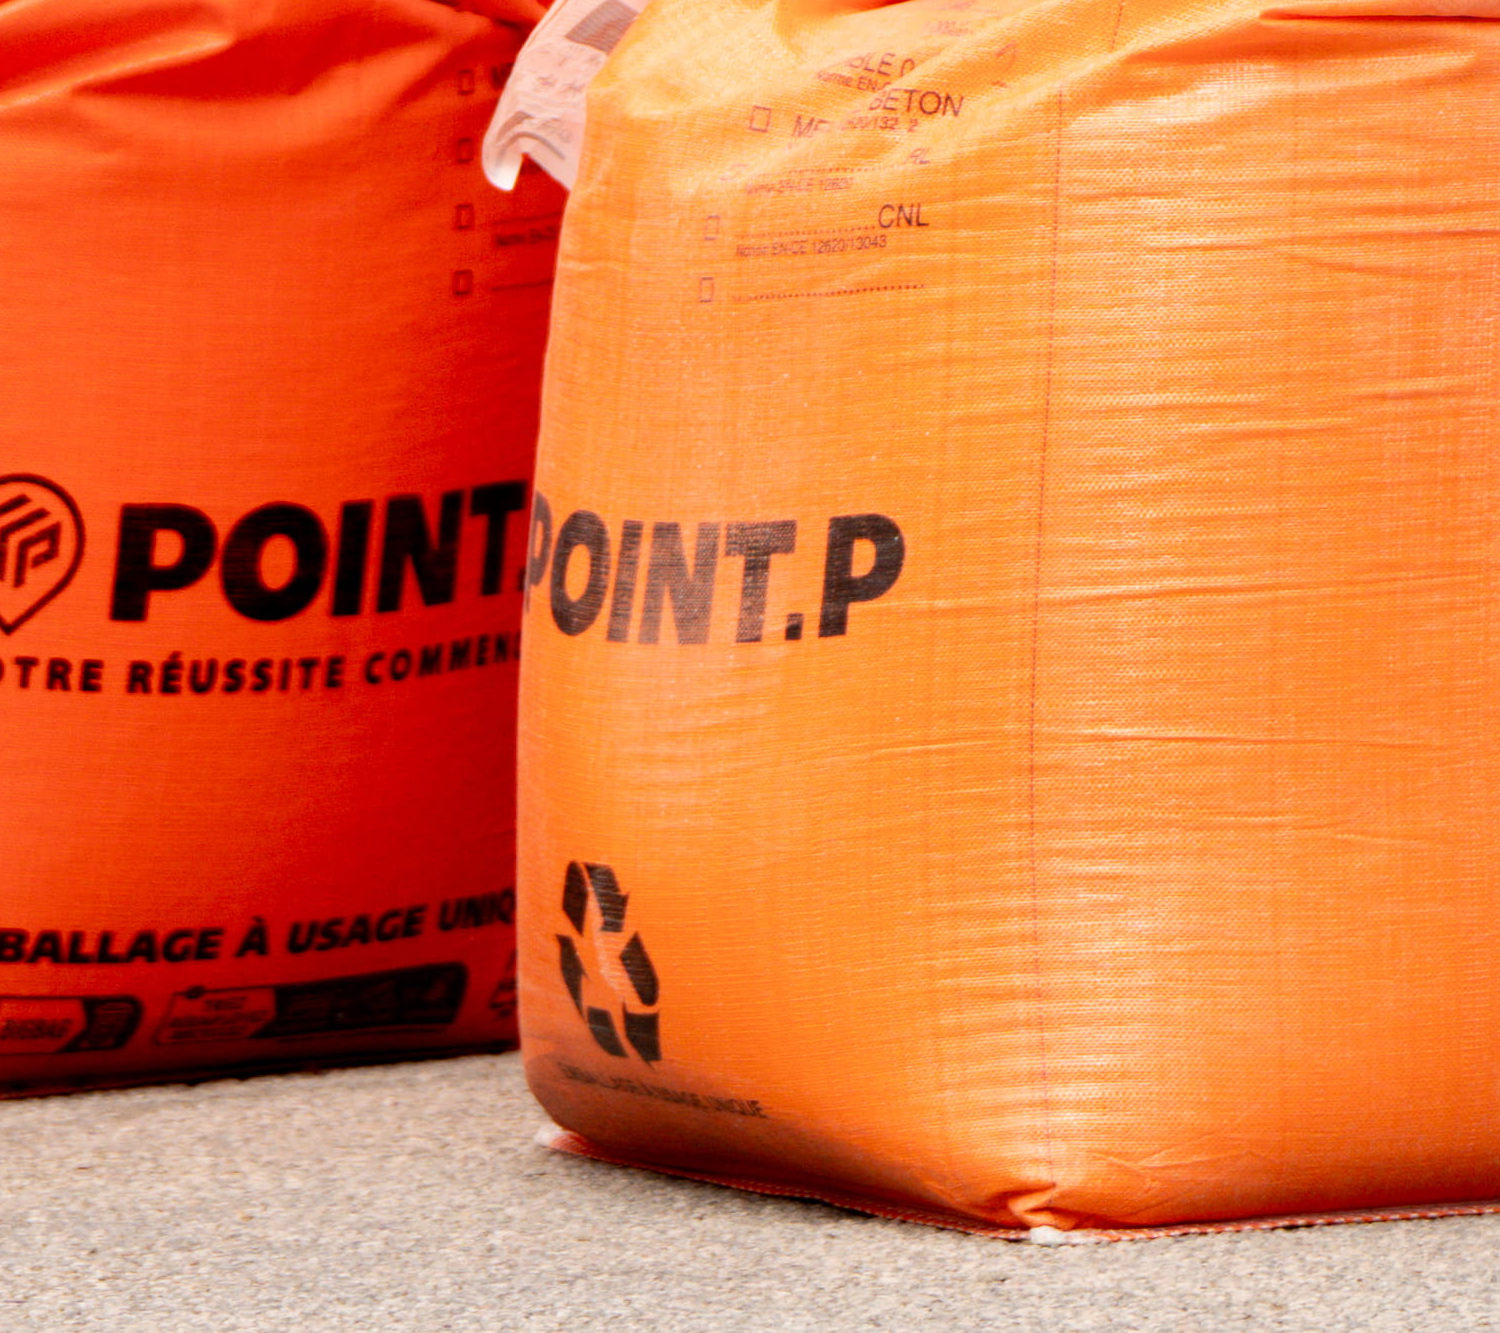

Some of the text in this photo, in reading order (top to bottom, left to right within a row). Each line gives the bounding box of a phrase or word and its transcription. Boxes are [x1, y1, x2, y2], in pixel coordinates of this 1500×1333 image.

[878, 202, 931, 229] CNL
[126, 651, 345, 696] RÉUSSITE
[236, 916, 269, 958] À
[286, 904, 429, 954] USAGE
